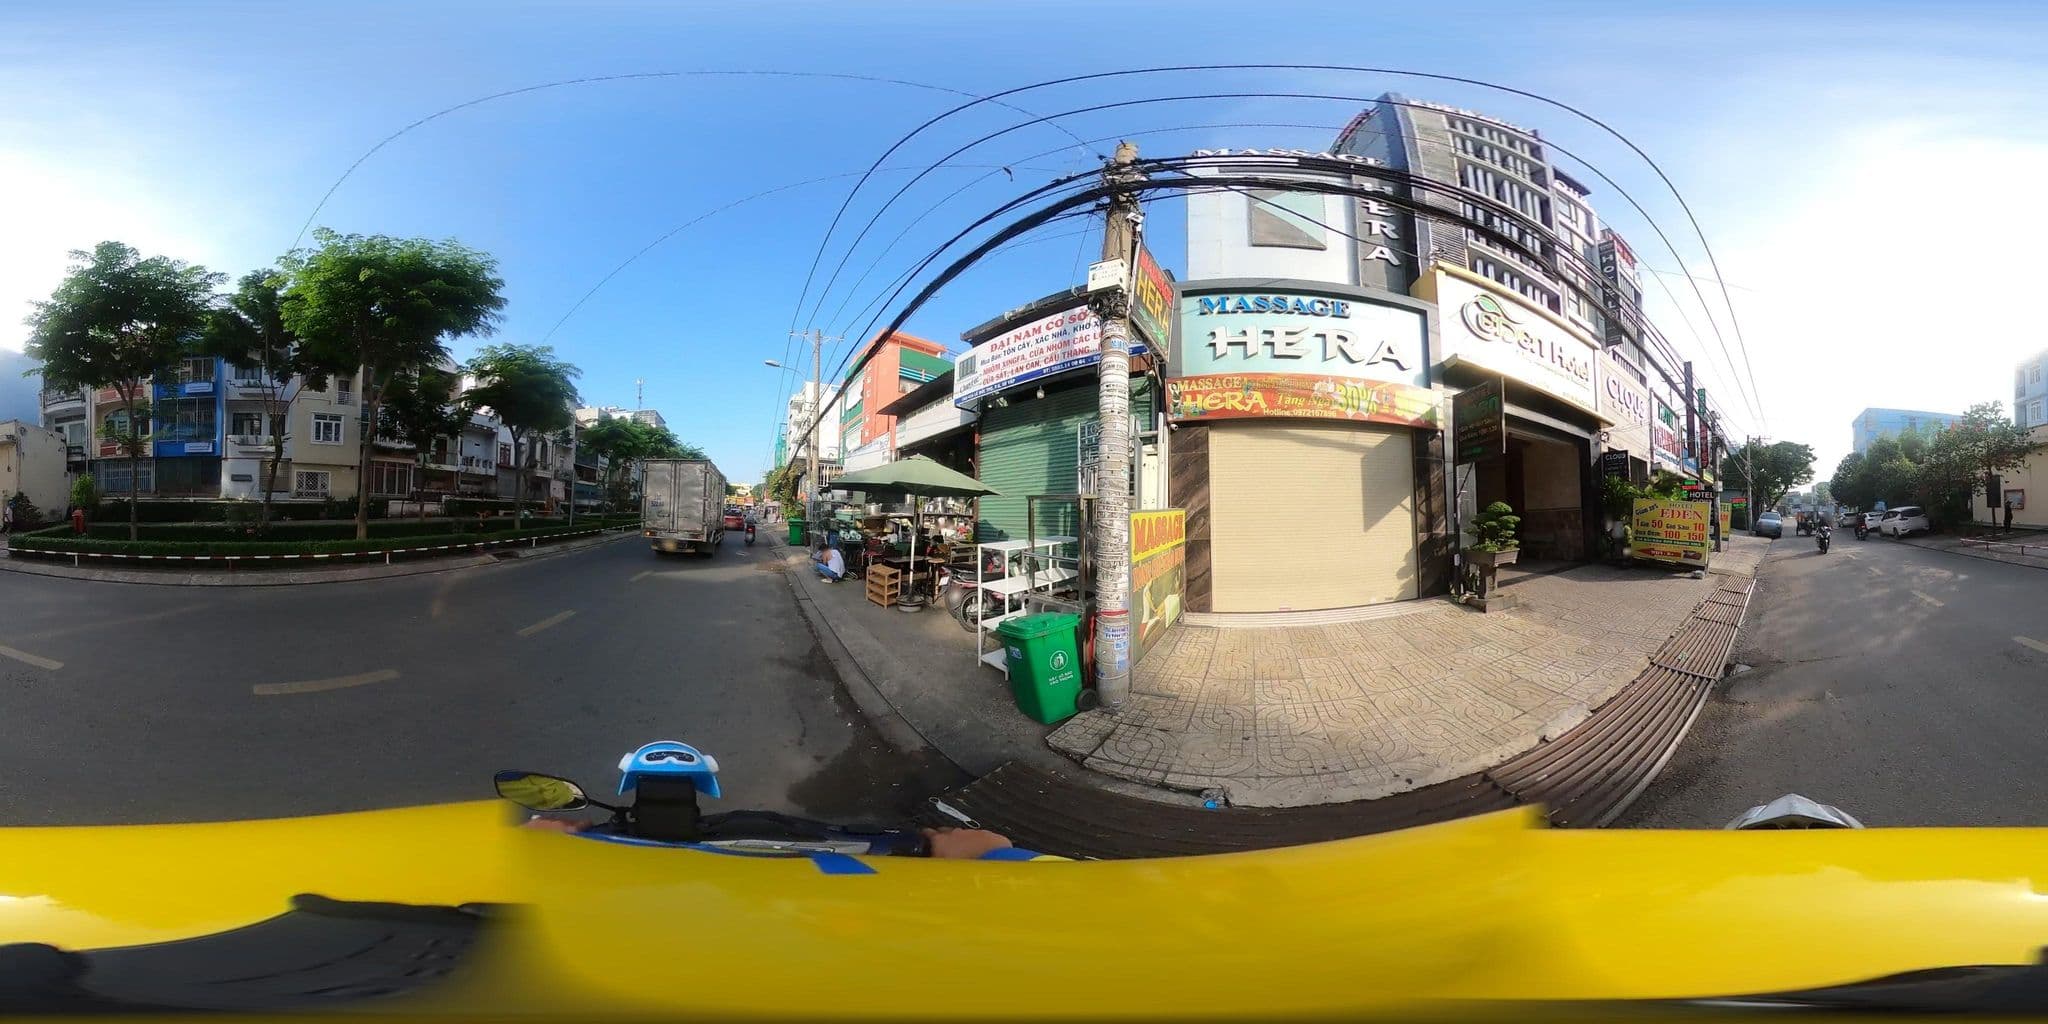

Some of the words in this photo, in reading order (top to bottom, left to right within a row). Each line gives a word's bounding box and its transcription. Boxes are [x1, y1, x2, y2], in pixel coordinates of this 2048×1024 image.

[1360, 183, 1401, 266] HERA
[1136, 267, 1169, 336] HERA
[1199, 294, 1351, 319] MASSAGE
[1014, 325, 1042, 343] NAM
[1045, 315, 1065, 331] CƠ
[1207, 323, 1412, 371] HERA
[1177, 376, 1241, 392] MASSAGE
[1182, 391, 1267, 411] HERA
[1690, 491, 1714, 499] HOTEL
[1659, 508, 1703, 520] EDEN
[1133, 514, 1184, 556] MASSAGE
[1651, 519, 1663, 529] 50
[1693, 522, 1705, 532] 10
[1663, 531, 1681, 540] 100
